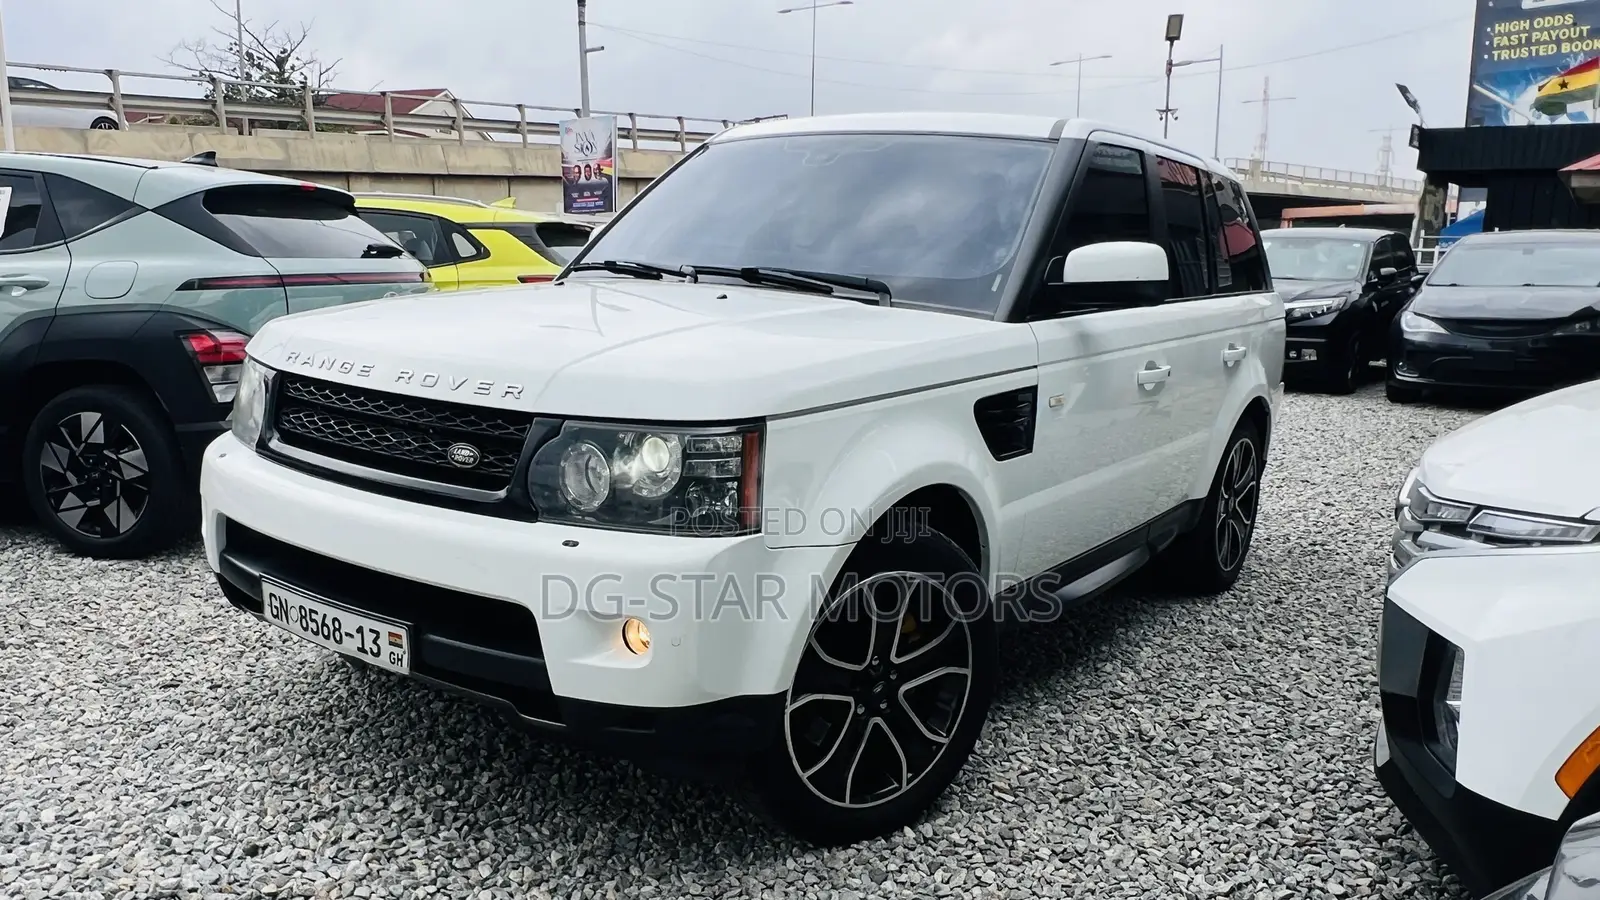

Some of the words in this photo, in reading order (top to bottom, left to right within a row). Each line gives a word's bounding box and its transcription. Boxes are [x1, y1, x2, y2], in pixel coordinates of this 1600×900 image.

[1495, 19, 1530, 34] HIGH
[1533, 13, 1574, 29] ODDS
[1493, 33, 1529, 48] FAST
[1531, 25, 1591, 43] PAYOUT
[1492, 43, 1558, 61] TRUSTED
[285, 351, 375, 378] RANGE
[394, 368, 525, 400] ROVER
[268, 592, 290, 625] GN
[298, 604, 381, 658] 8568-13
[388, 651, 404, 668] GH
